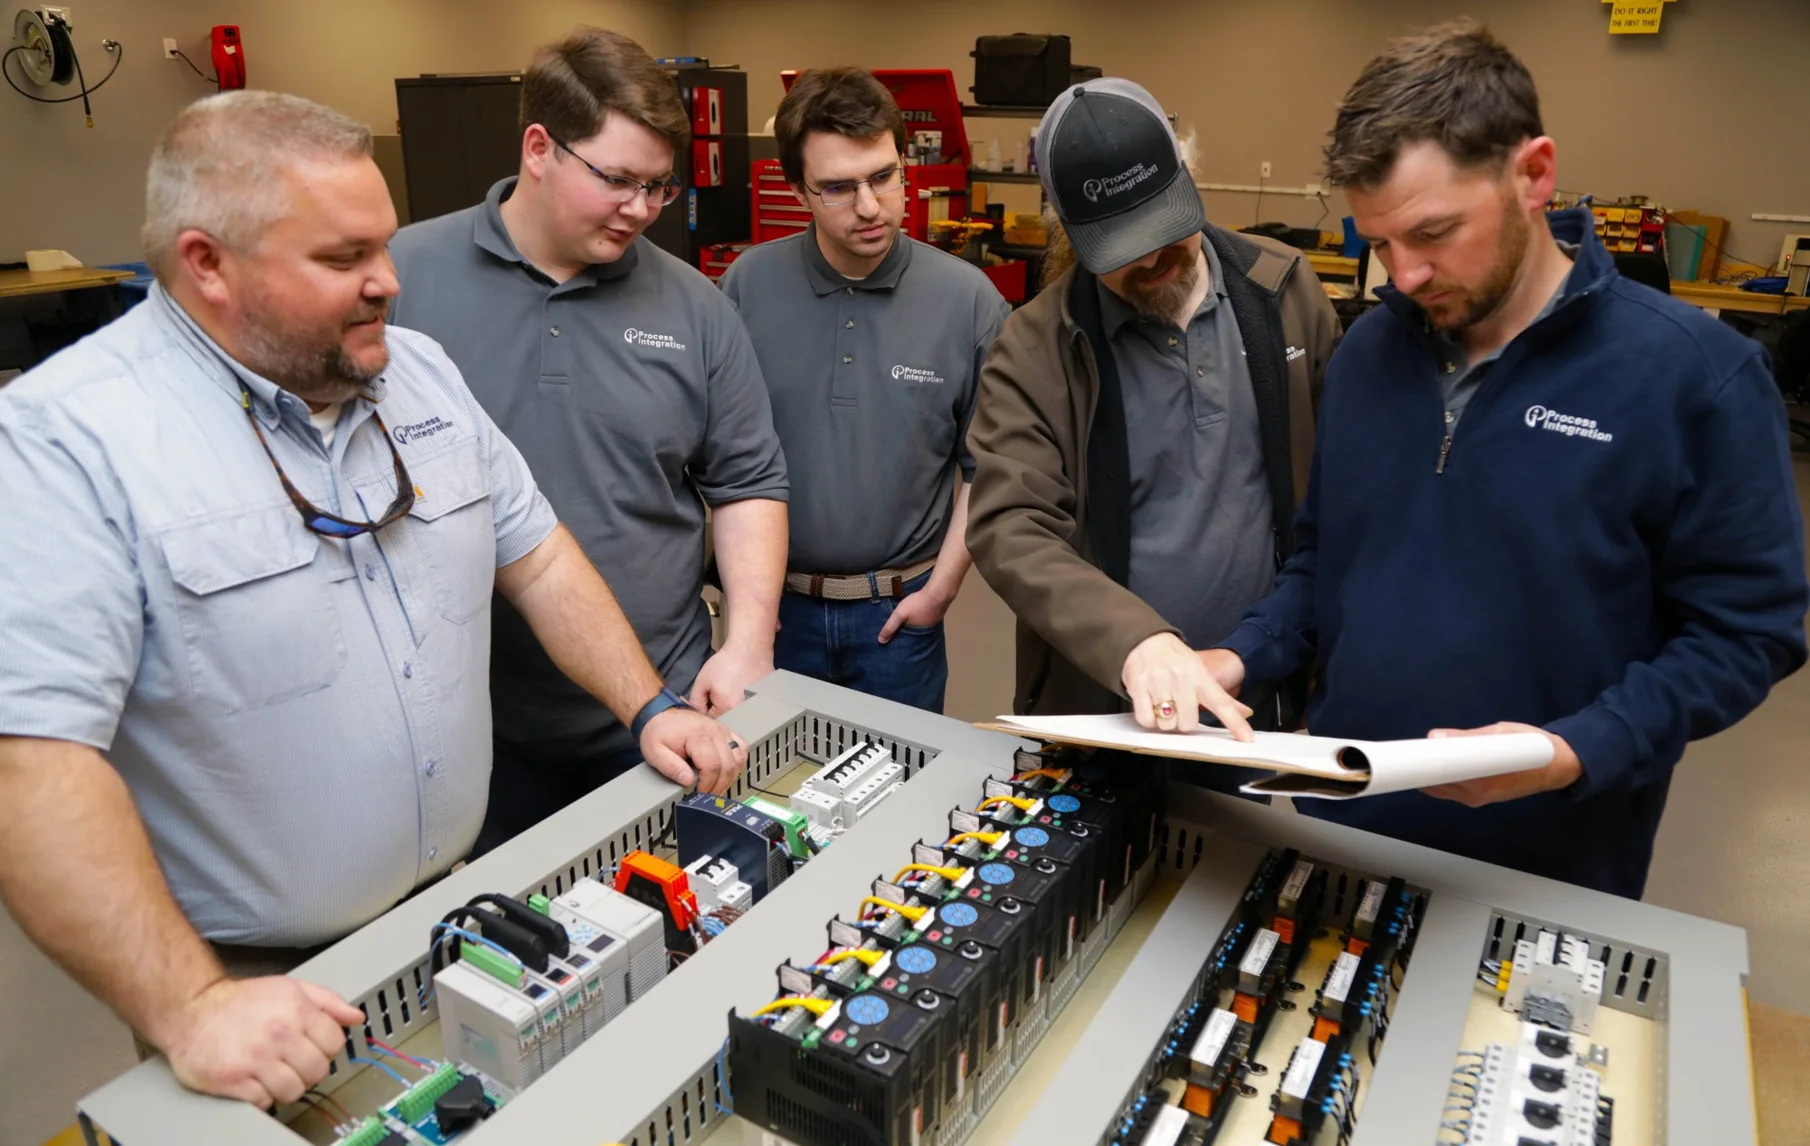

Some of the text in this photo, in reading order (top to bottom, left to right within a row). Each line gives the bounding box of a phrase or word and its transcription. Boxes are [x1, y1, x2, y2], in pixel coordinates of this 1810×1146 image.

[1614, 7, 1658, 15] DO IT RIGHT
[1101, 162, 1144, 188] Process
[1104, 164, 1159, 197] Integration
[638, 330, 674, 342] Process
[638, 337, 686, 351] Integration
[903, 373, 945, 384] Integration
[904, 366, 935, 377] Process
[404, 416, 441, 433] Process
[1547, 409, 1598, 429] Process
[408, 420, 455, 441] Integration
[1542, 419, 1613, 442] Integration
